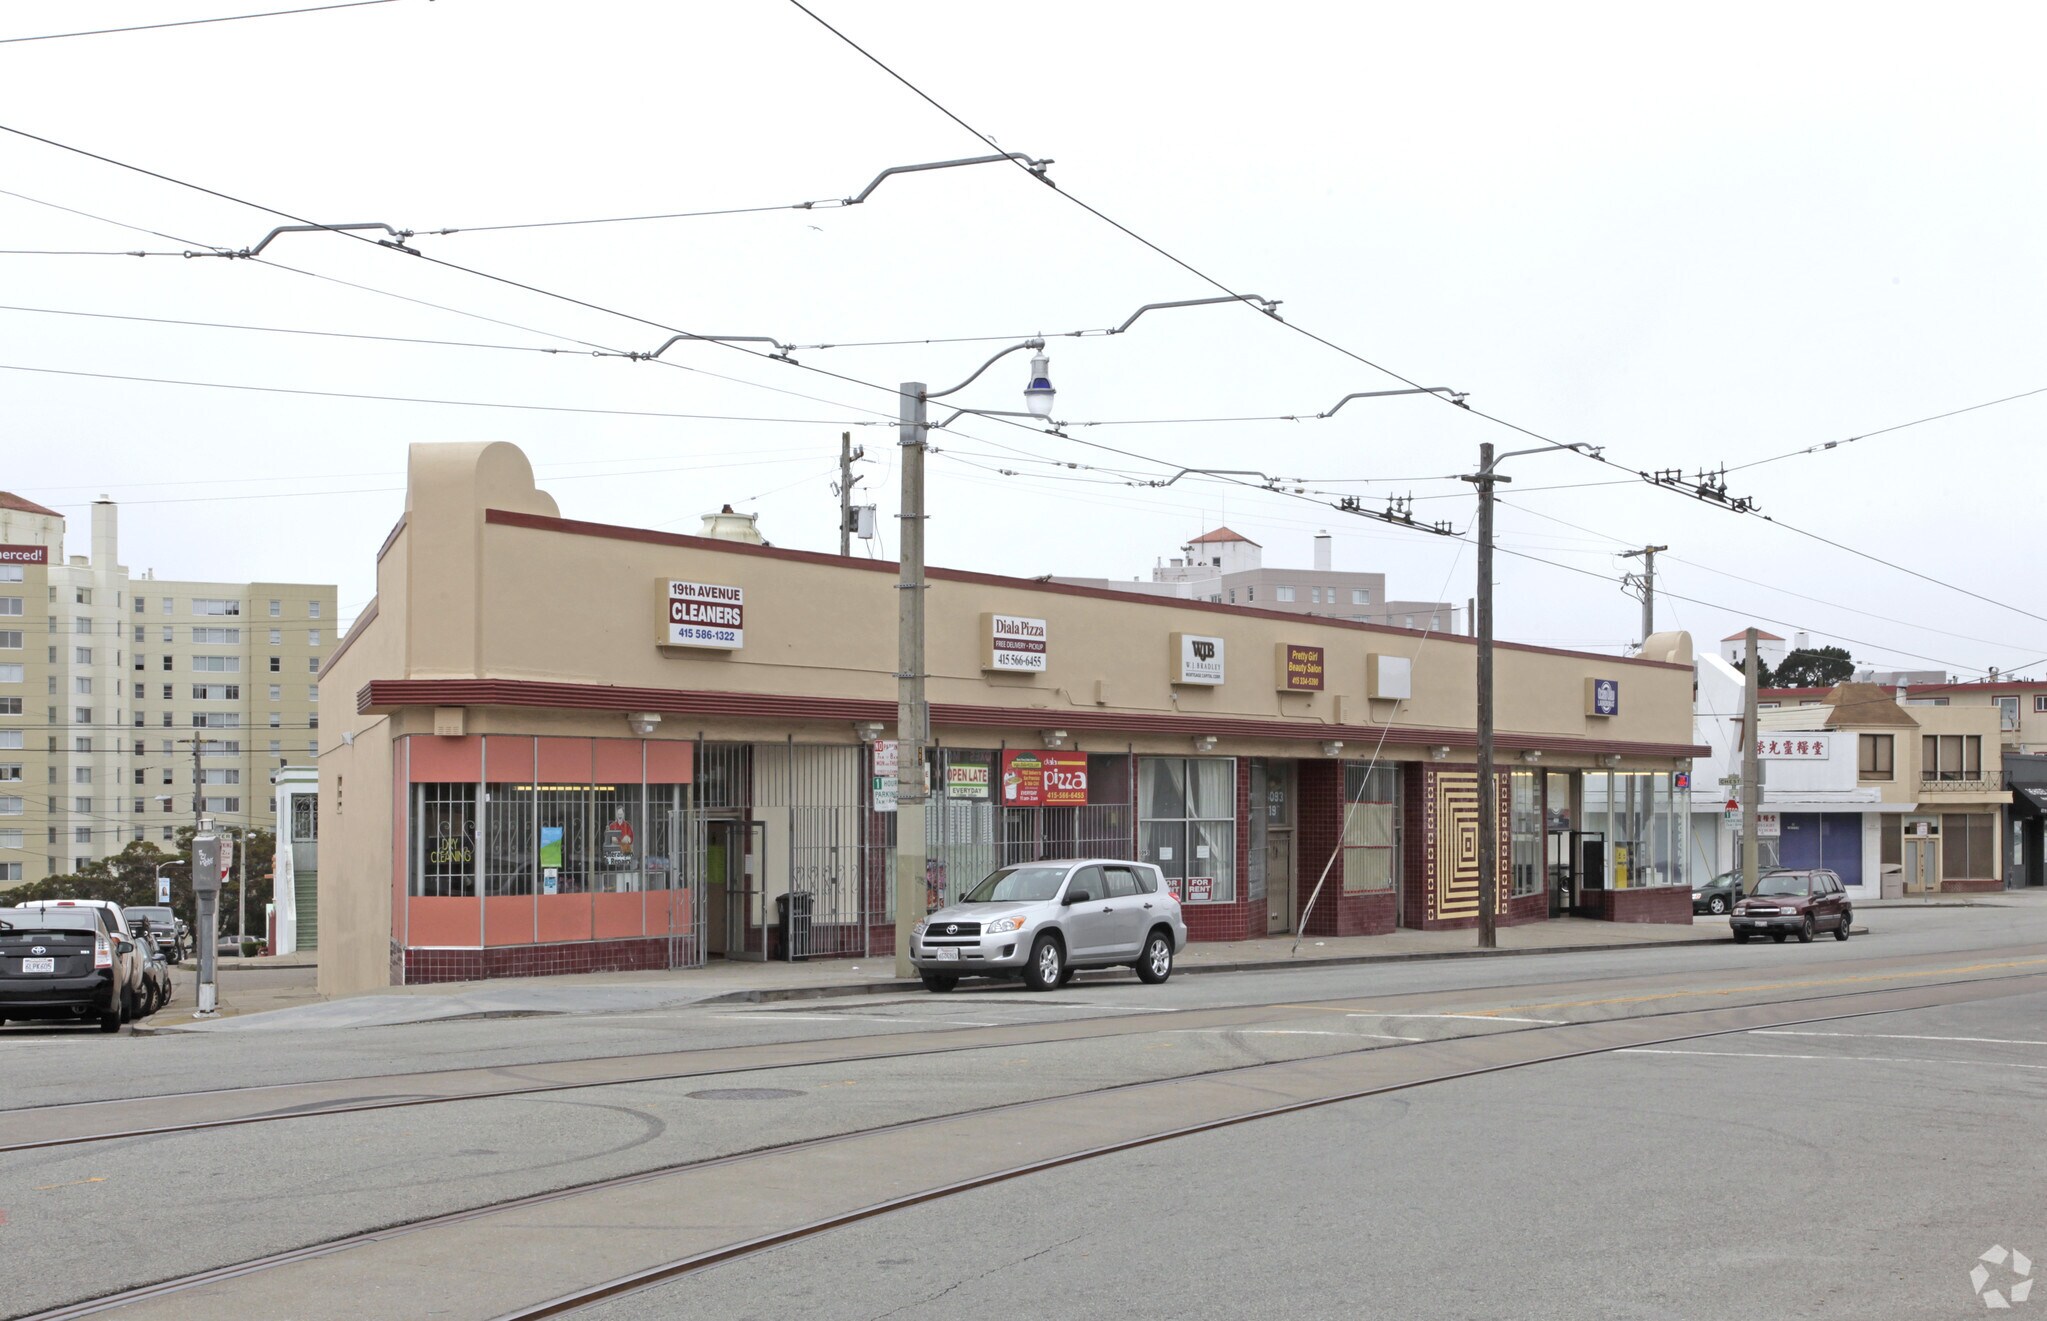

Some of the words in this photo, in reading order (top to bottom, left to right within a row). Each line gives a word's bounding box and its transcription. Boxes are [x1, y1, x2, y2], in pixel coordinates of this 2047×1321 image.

[0, 550, 42, 561] erced!
[672, 584, 695, 596] 19th
[698, 586, 740, 601] AVENUE
[672, 602, 740, 625] CLEANERS
[679, 628, 693, 638] 415
[998, 654, 1009, 664] 415
[1011, 655, 1041, 667] 566-6455
[1292, 650, 1307, 662] Pretty
[1308, 652, 1318, 661] Girl
[1289, 662, 1306, 674] Beauty
[1308, 664, 1322, 673] Salon
[947, 768, 967, 781] OPEN
[969, 769, 987, 782] LATE
[1044, 768, 1086, 790] pizza
[442, 838, 458, 850] DRY
